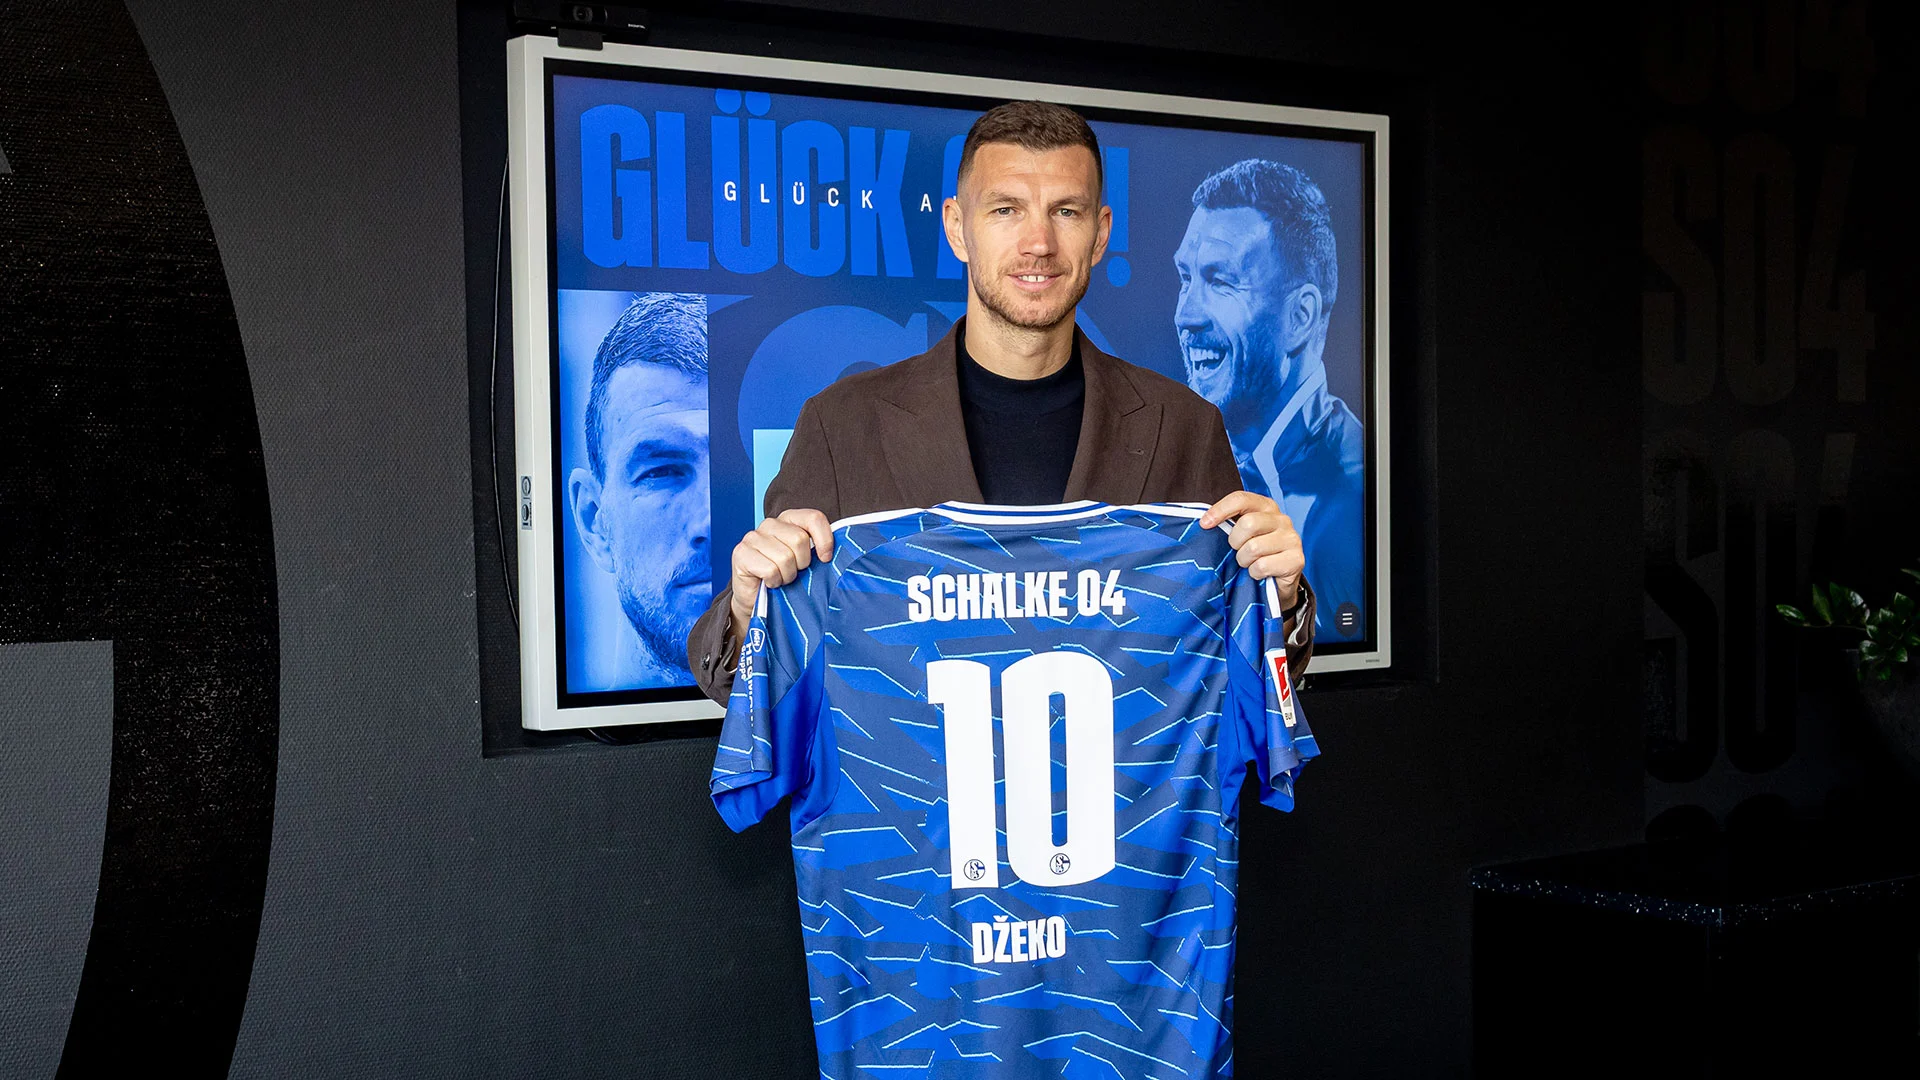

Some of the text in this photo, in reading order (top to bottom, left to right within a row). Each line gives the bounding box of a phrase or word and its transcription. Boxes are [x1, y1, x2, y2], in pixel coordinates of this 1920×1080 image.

[580, 89, 912, 279] GLÜCK
[724, 181, 873, 209] GLÜCK
[907, 569, 1126, 623] SCHALKE 04
[926, 651, 1115, 889] 10
[972, 915, 1066, 964] DŽEKO
